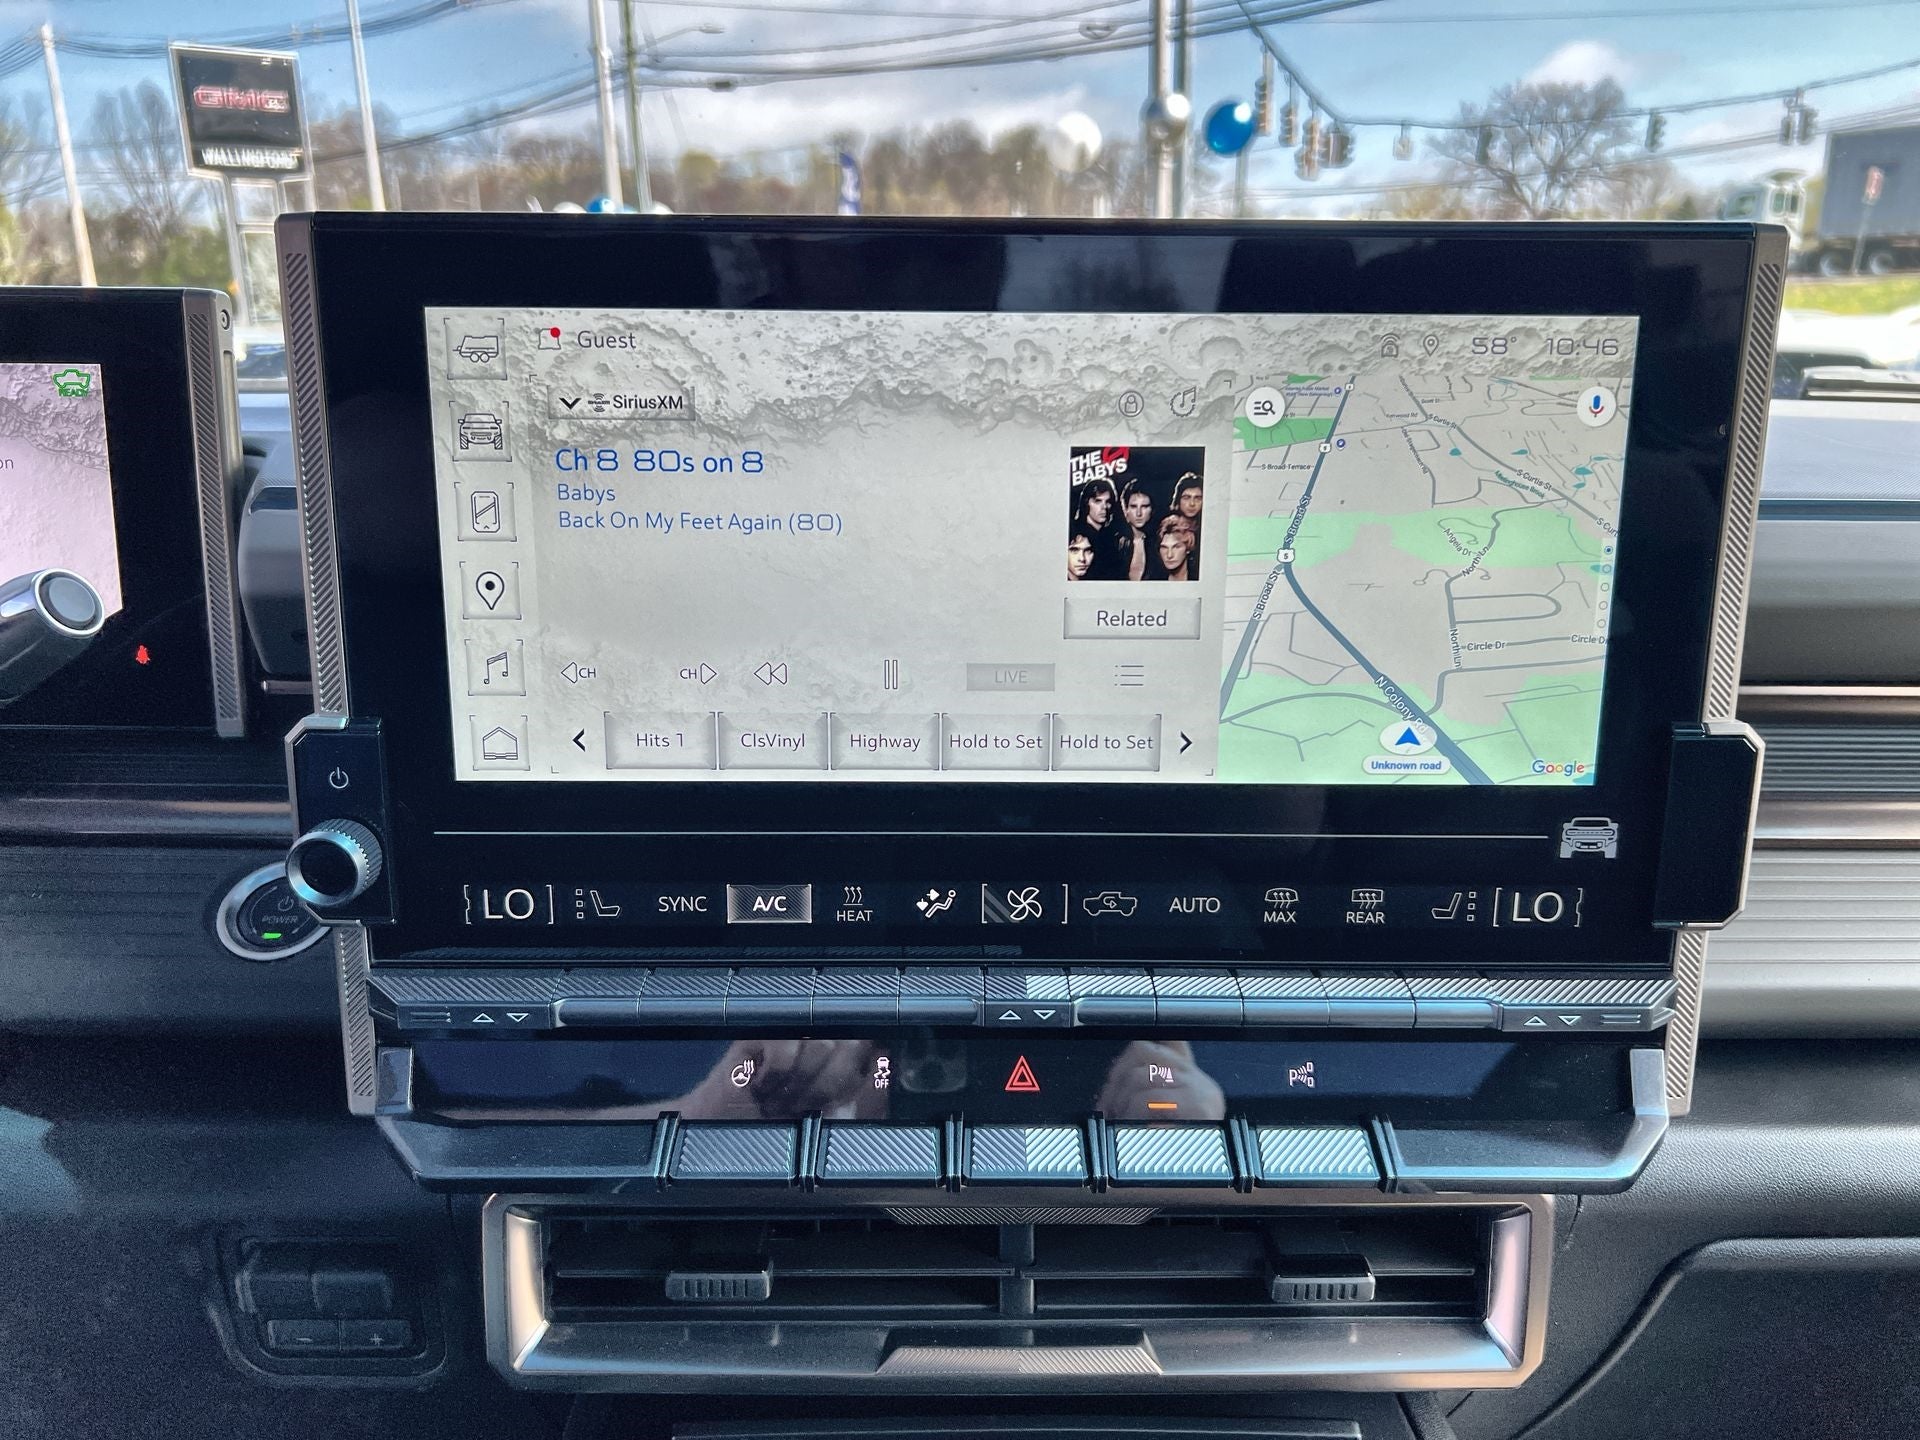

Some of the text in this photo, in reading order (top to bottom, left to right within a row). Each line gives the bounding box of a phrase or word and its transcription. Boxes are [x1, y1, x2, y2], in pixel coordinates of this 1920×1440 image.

[577, 330, 637, 349] Guest
[1546, 338, 1619, 356] 10:46
[59, 388, 88, 397] READY
[613, 394, 683, 410] SiriusXM
[1433, 415, 1451, 427] Curtis
[1450, 422, 1458, 430] St
[556, 449, 764, 473] Ch 8 80s on 8
[1070, 450, 1102, 471] THE
[1261, 463, 1267, 471] S
[1287, 463, 1311, 471] Terrace
[1072, 458, 1128, 487] BABYS
[1516, 469, 1552, 491] S Curtis St
[557, 483, 616, 506] Babys
[559, 511, 842, 535] Back On My Feet Again (80)
[1284, 495, 1311, 545] S Broad St
[1597, 517, 1605, 526] S
[1444, 528, 1472, 556] Angela Dr
[1461, 546, 1489, 577] North Ln
[1253, 570, 1280, 620] S Broad St
[1096, 609, 1167, 627] Related
[1467, 641, 1506, 651] Circle Dr
[1571, 635, 1597, 643] Circle
[1450, 628, 1462, 668] North Ln
[578, 667, 597, 679] CH
[679, 668, 698, 680] CH
[994, 670, 1028, 684] LIVE
[1376, 675, 1429, 734] N Colony Rd
[636, 733, 684, 747] Hits 1
[740, 733, 806, 751] ClsVinyl
[850, 734, 921, 752] Highway
[950, 734, 1043, 749] Hold to Set
[1060, 735, 1154, 750] Hold to Set
[1371, 761, 1442, 770] Unknown road
[1532, 760, 1585, 777] Google
[482, 888, 535, 920] LO
[658, 896, 707, 913] SYNC
[752, 896, 787, 912] A/C
[1169, 897, 1221, 914] AUTO
[1512, 891, 1563, 922] LO
[836, 909, 874, 922] HEAT
[1263, 911, 1297, 924] MAX
[1346, 911, 1385, 924] REAR
[874, 1078, 889, 1089] OFF
